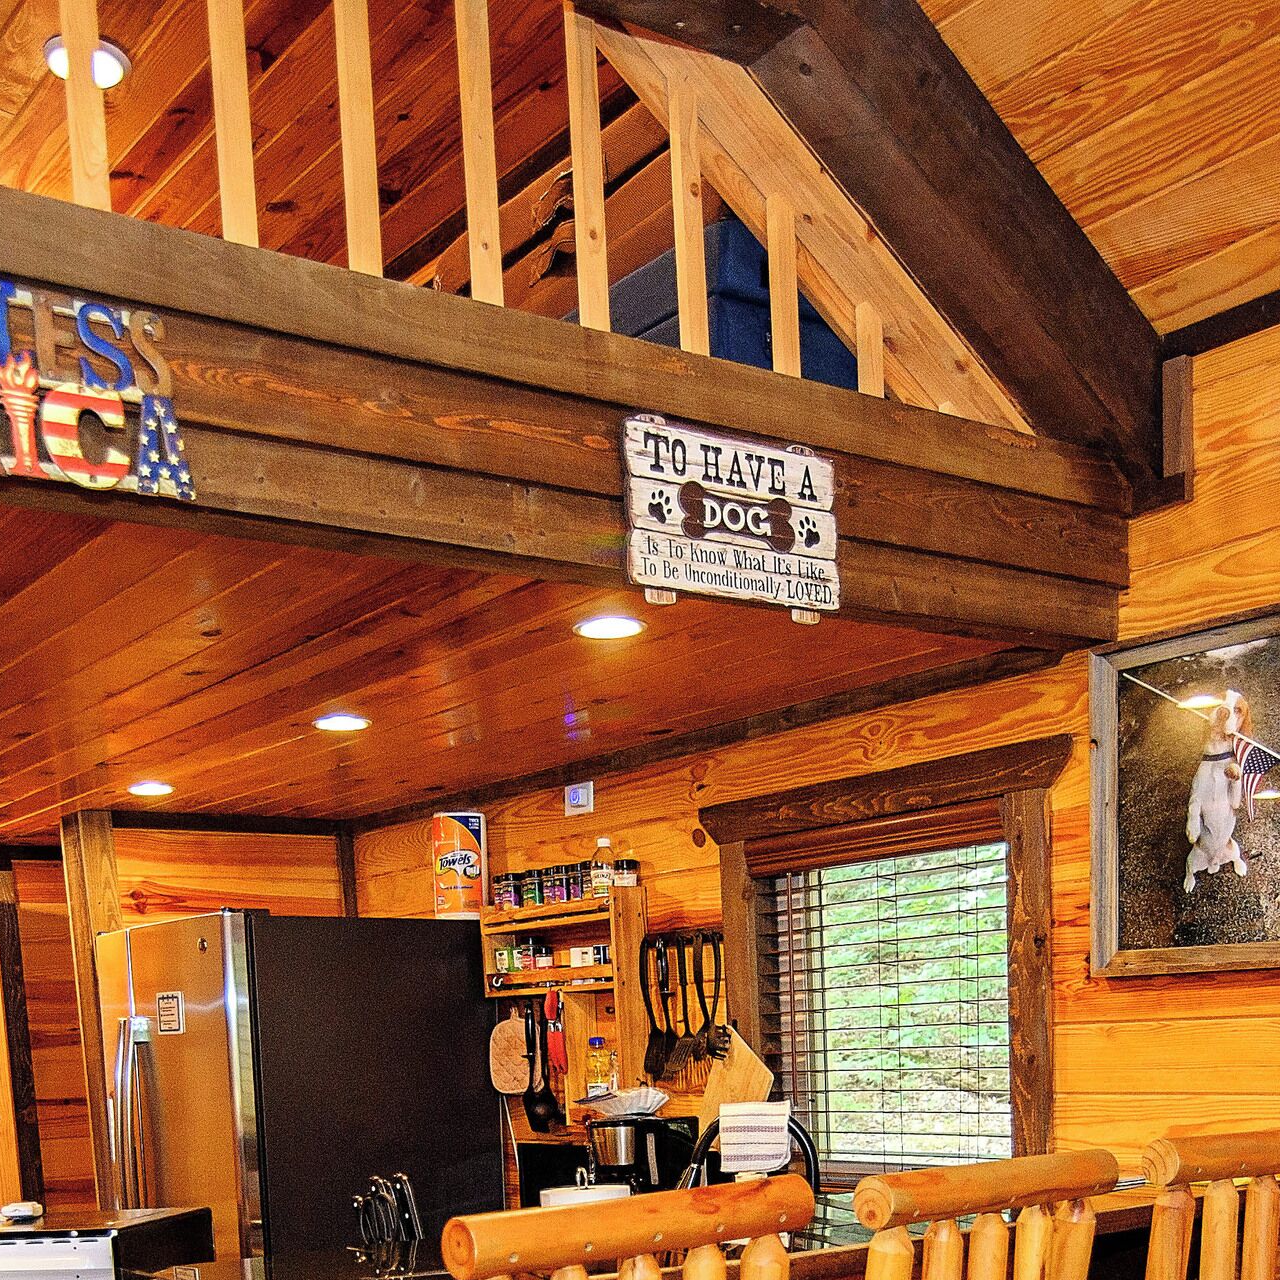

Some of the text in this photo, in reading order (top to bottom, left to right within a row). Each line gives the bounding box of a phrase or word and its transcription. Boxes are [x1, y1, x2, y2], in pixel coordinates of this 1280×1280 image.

[643, 432, 818, 502] TO HAVE A
[703, 498, 771, 537] DOG
[641, 557, 657, 576] To
[663, 560, 679, 580] Be
[685, 563, 782, 599] Unconditionally
[646, 536, 825, 581] Is To Know What It's Like
